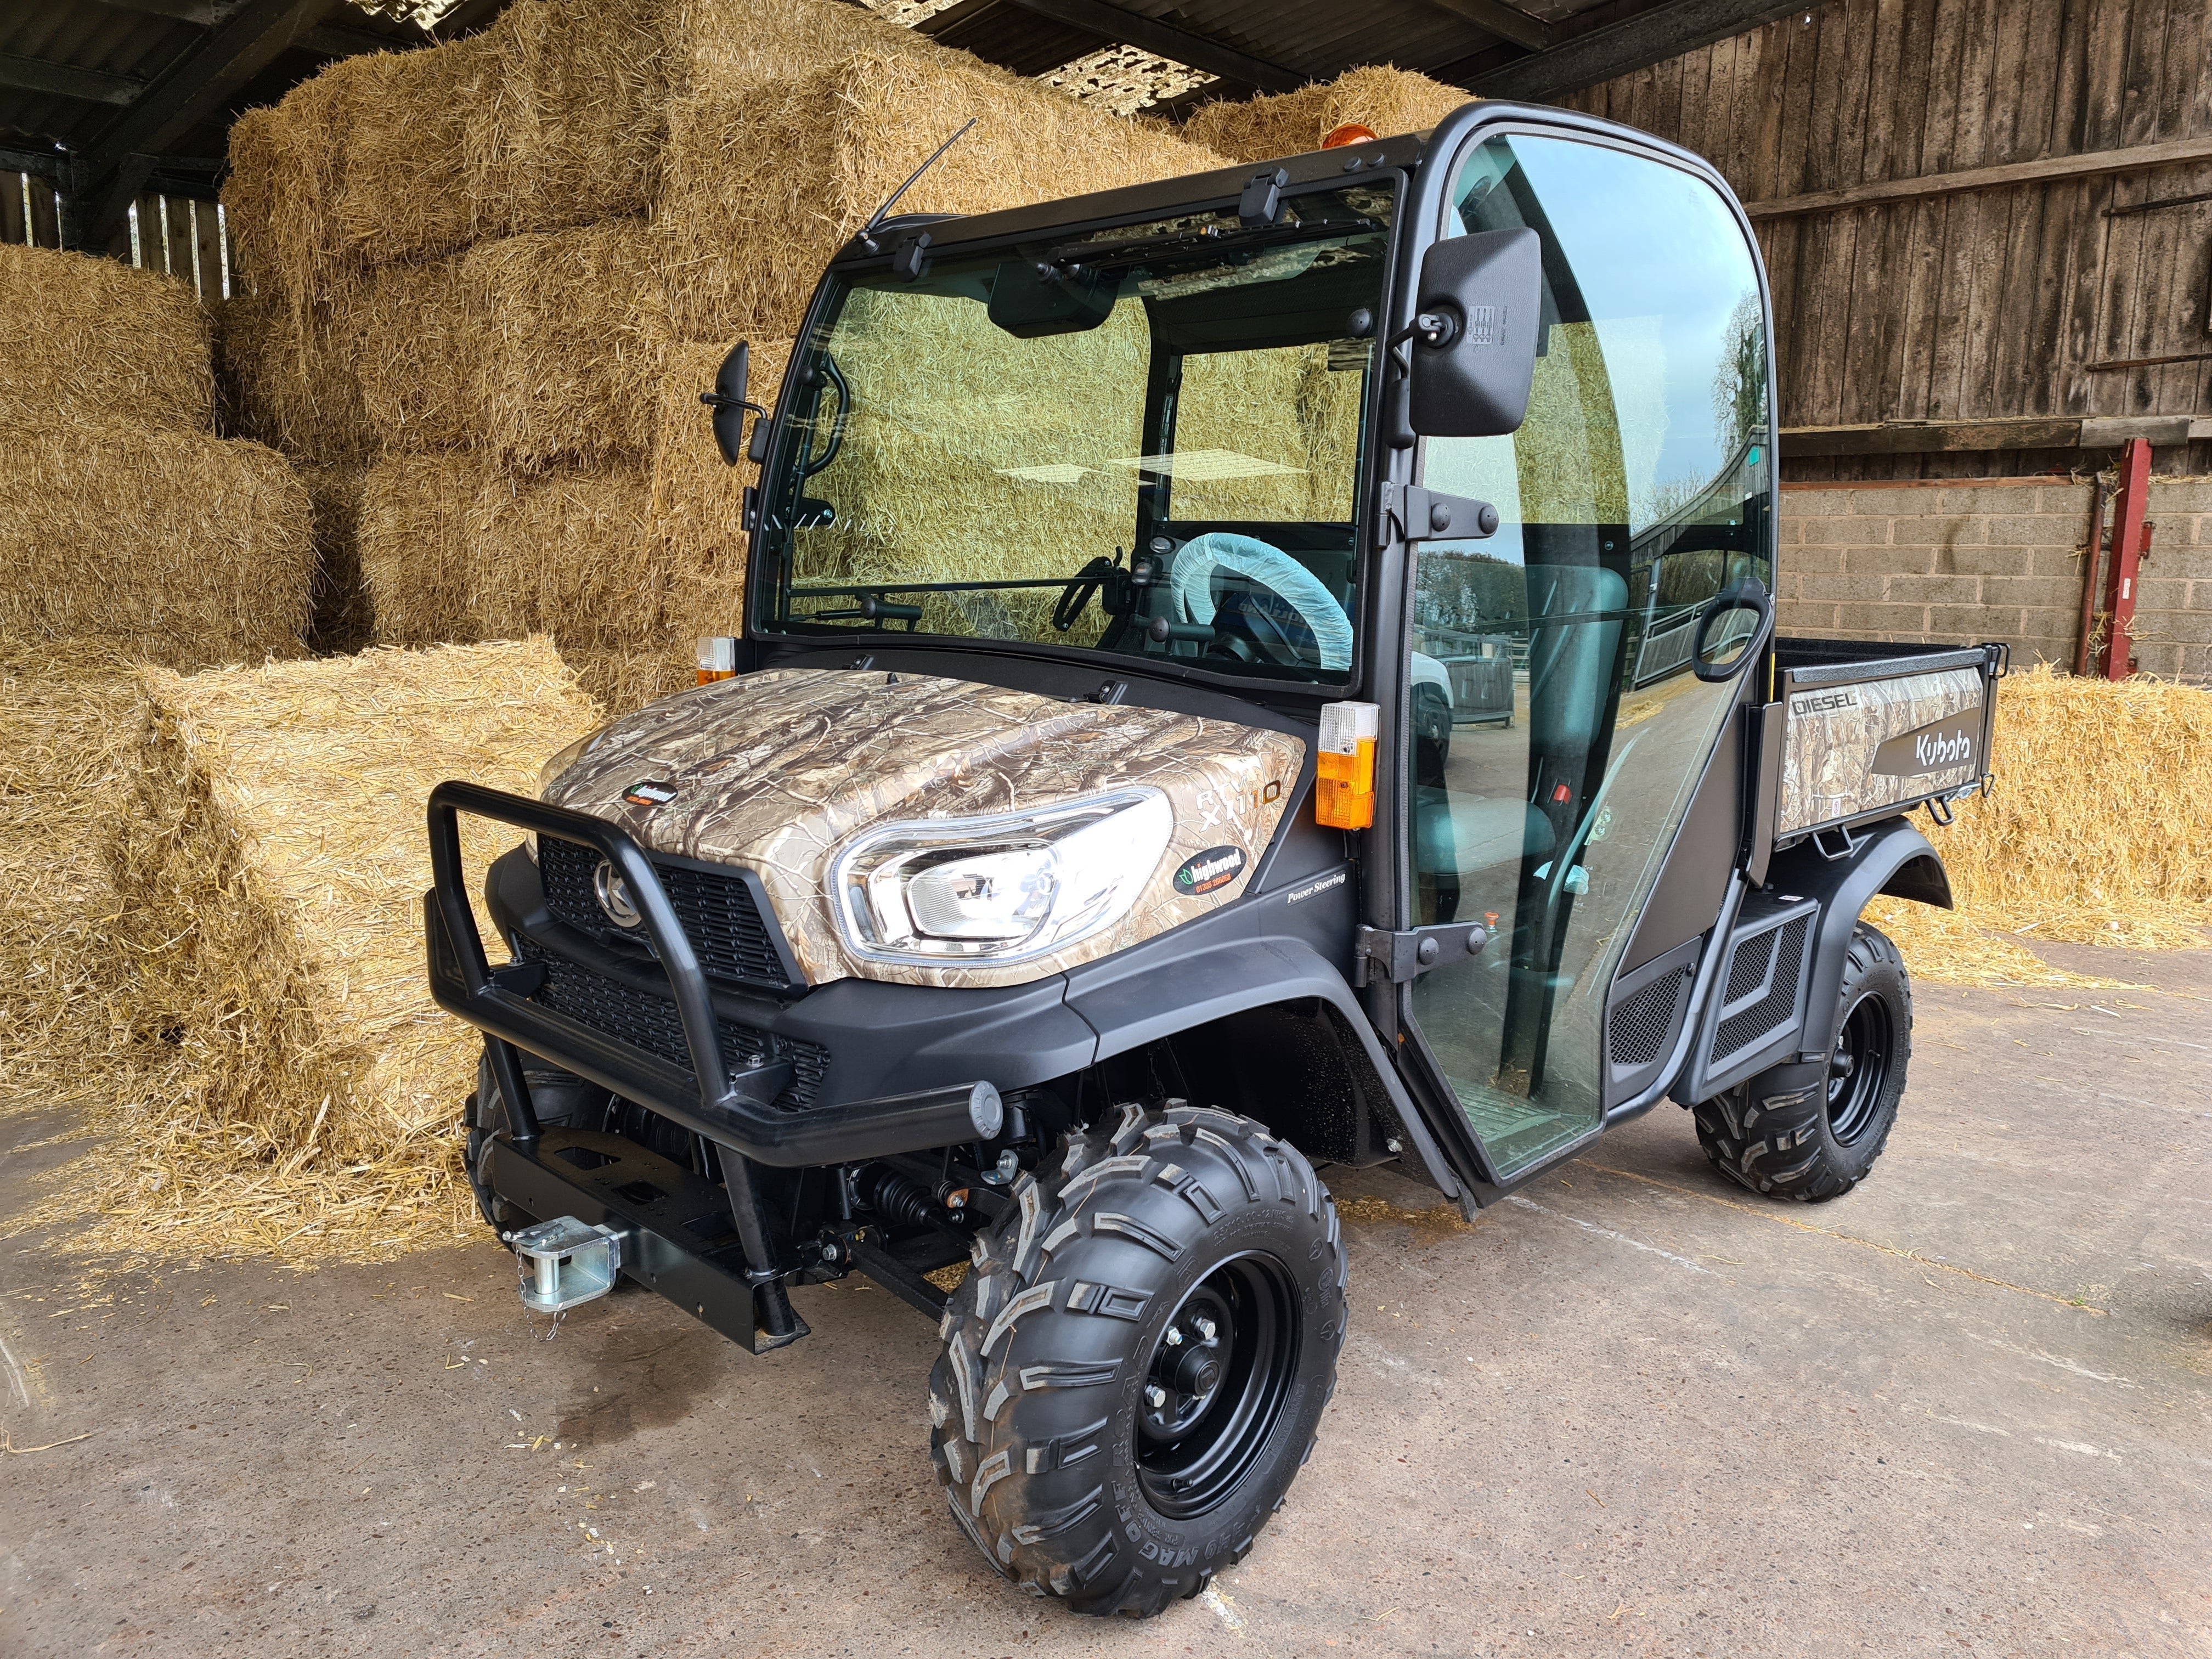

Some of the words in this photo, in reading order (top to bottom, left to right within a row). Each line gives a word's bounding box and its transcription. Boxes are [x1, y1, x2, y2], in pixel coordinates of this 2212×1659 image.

[1792, 693, 1858, 716] DIESEL
[1916, 729, 1970, 766] Kubota
[1195, 775, 1247, 810] RTV
[1199, 780, 1281, 833] X1110
[1191, 848, 1242, 883] highwood
[1196, 881, 1212, 894] 01305
[1212, 873, 1232, 887] 266058
[1287, 887, 1313, 904] Power
[1314, 873, 1346, 893] Steering
[1111, 1480, 1142, 1543] OFF
[1138, 1541, 1199, 1568] MAG
